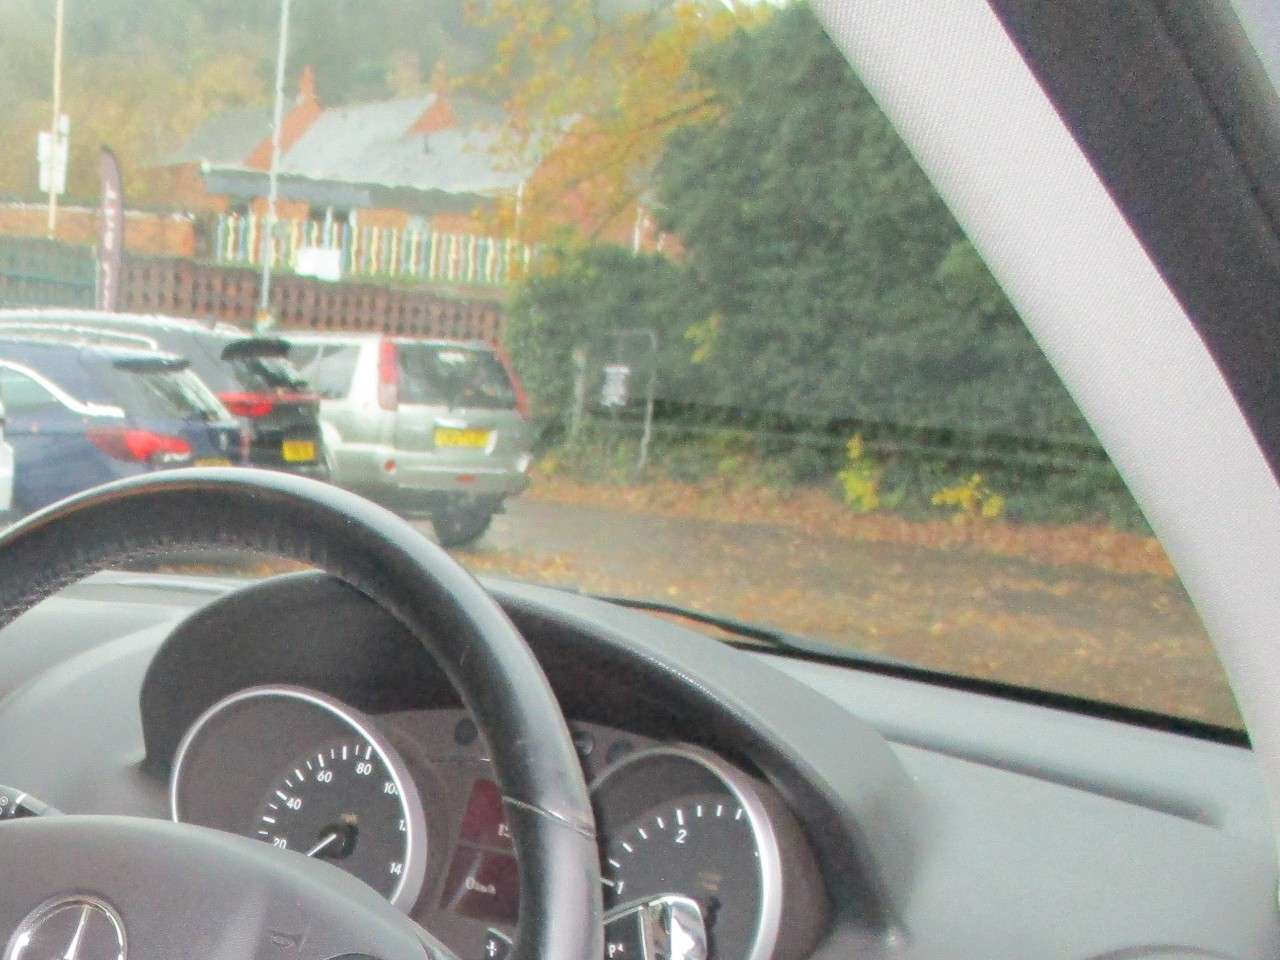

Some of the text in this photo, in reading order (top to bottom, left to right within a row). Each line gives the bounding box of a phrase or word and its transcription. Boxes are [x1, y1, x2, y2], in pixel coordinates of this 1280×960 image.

[356, 762, 372, 775] 80
[317, 770, 332, 783] 60
[384, 782, 399, 795] 10
[286, 798, 302, 810] 40
[676, 828, 688, 844] 2
